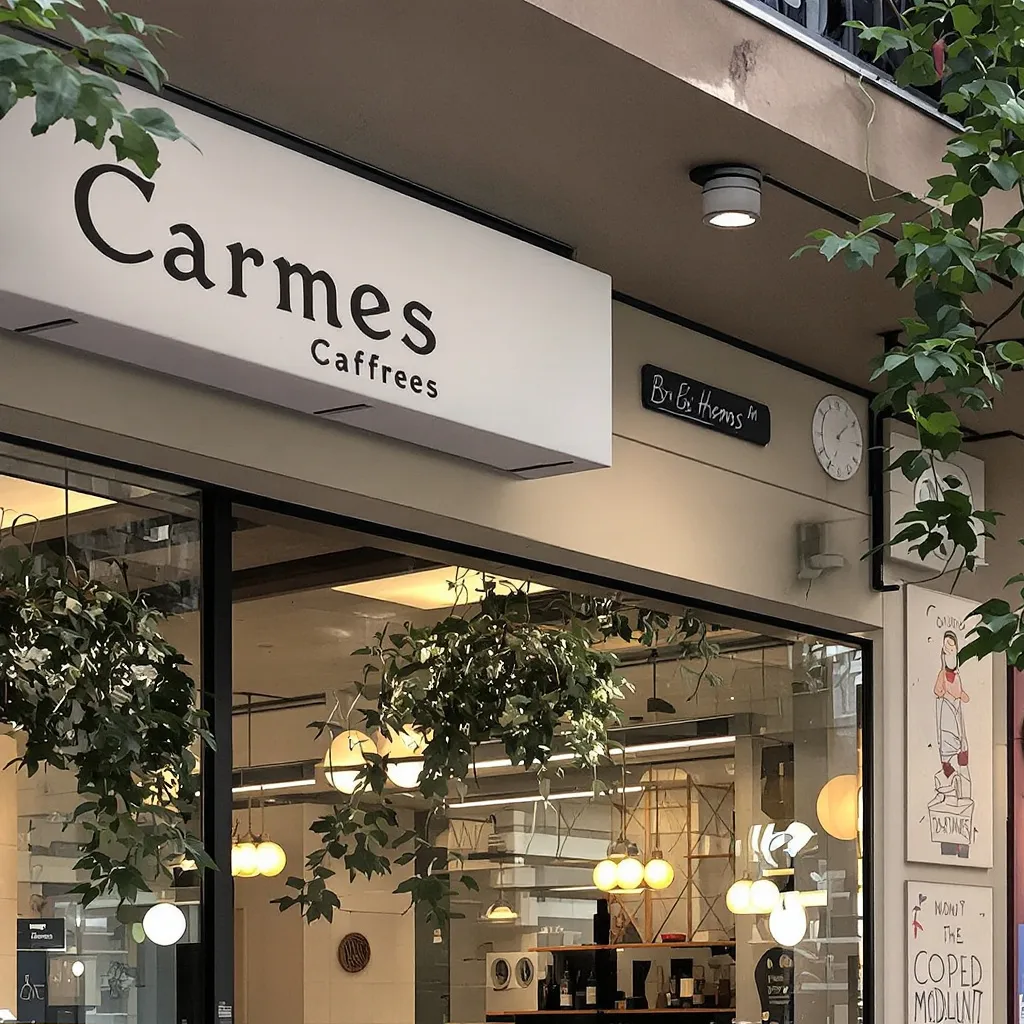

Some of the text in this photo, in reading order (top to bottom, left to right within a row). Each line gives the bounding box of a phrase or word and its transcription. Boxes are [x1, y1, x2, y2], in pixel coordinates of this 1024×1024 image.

[74, 163, 437, 355] Carmes
[311, 338, 438, 399] Caffrees
[913, 950, 983, 988] COPED
